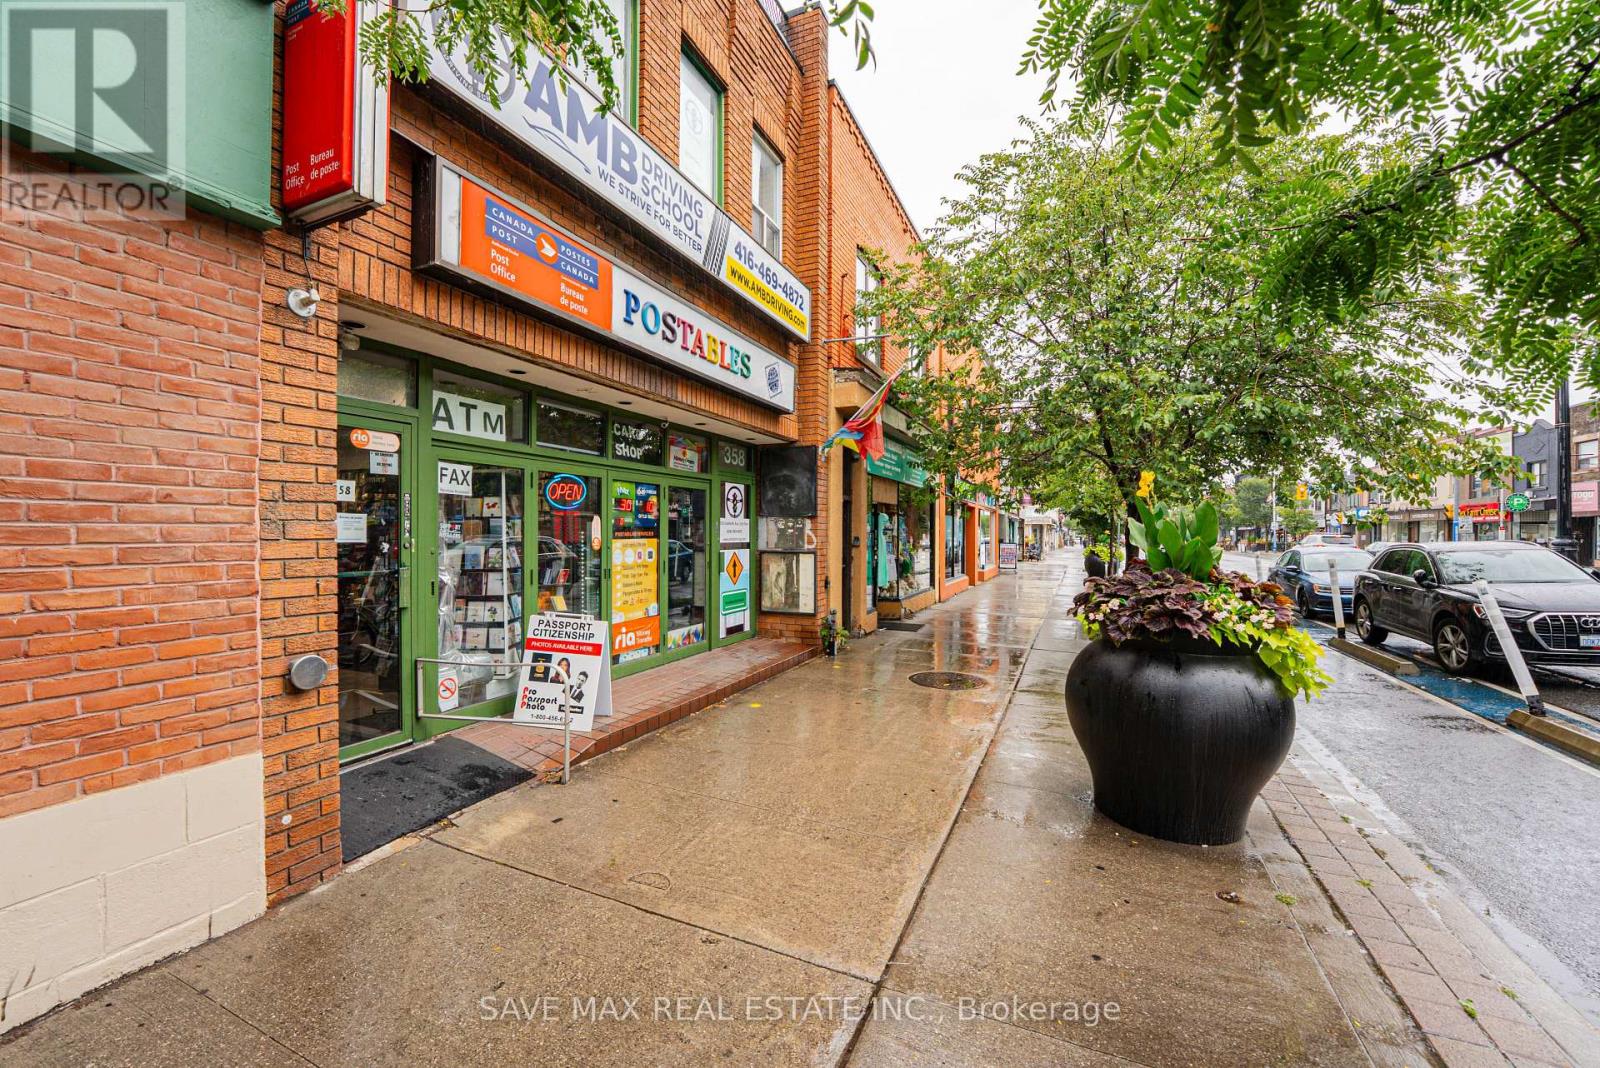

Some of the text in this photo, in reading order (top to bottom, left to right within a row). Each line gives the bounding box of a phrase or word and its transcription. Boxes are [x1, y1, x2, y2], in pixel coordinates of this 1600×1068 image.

[524, 61, 638, 185] AMB
[310, 148, 334, 166] Bureau
[285, 162, 299, 176] Post
[310, 160, 338, 180] de poste
[285, 176, 305, 190] Office
[642, 152, 703, 219] DRIVING
[598, 165, 702, 254] WE STRIVE FOR BETTER
[641, 175, 703, 240] SCHOOL
[492, 207, 534, 236] CANADA
[492, 225, 518, 245] POST
[491, 249, 510, 267] Post
[560, 245, 591, 267] POSTES
[490, 263, 517, 283] Office
[560, 262, 594, 284] CANADA
[734, 241, 804, 312] 416-469-4872
[560, 282, 585, 302] Bureau
[560, 296, 589, 316] de poste
[623, 288, 752, 379] POSTABLES
[432, 397, 505, 435] ATM
[615, 442, 644, 460] SHOP
[724, 446, 745, 467] 358
[440, 467, 470, 487] FAX
[549, 483, 583, 500] OPEN
[533, 628, 595, 641] CITIZENSHIP
[538, 619, 593, 632] PASSPORT
[615, 627, 636, 649] ria
[522, 694, 557, 705] Passport
[523, 687, 537, 695] Pro
[521, 702, 545, 711] Photo
